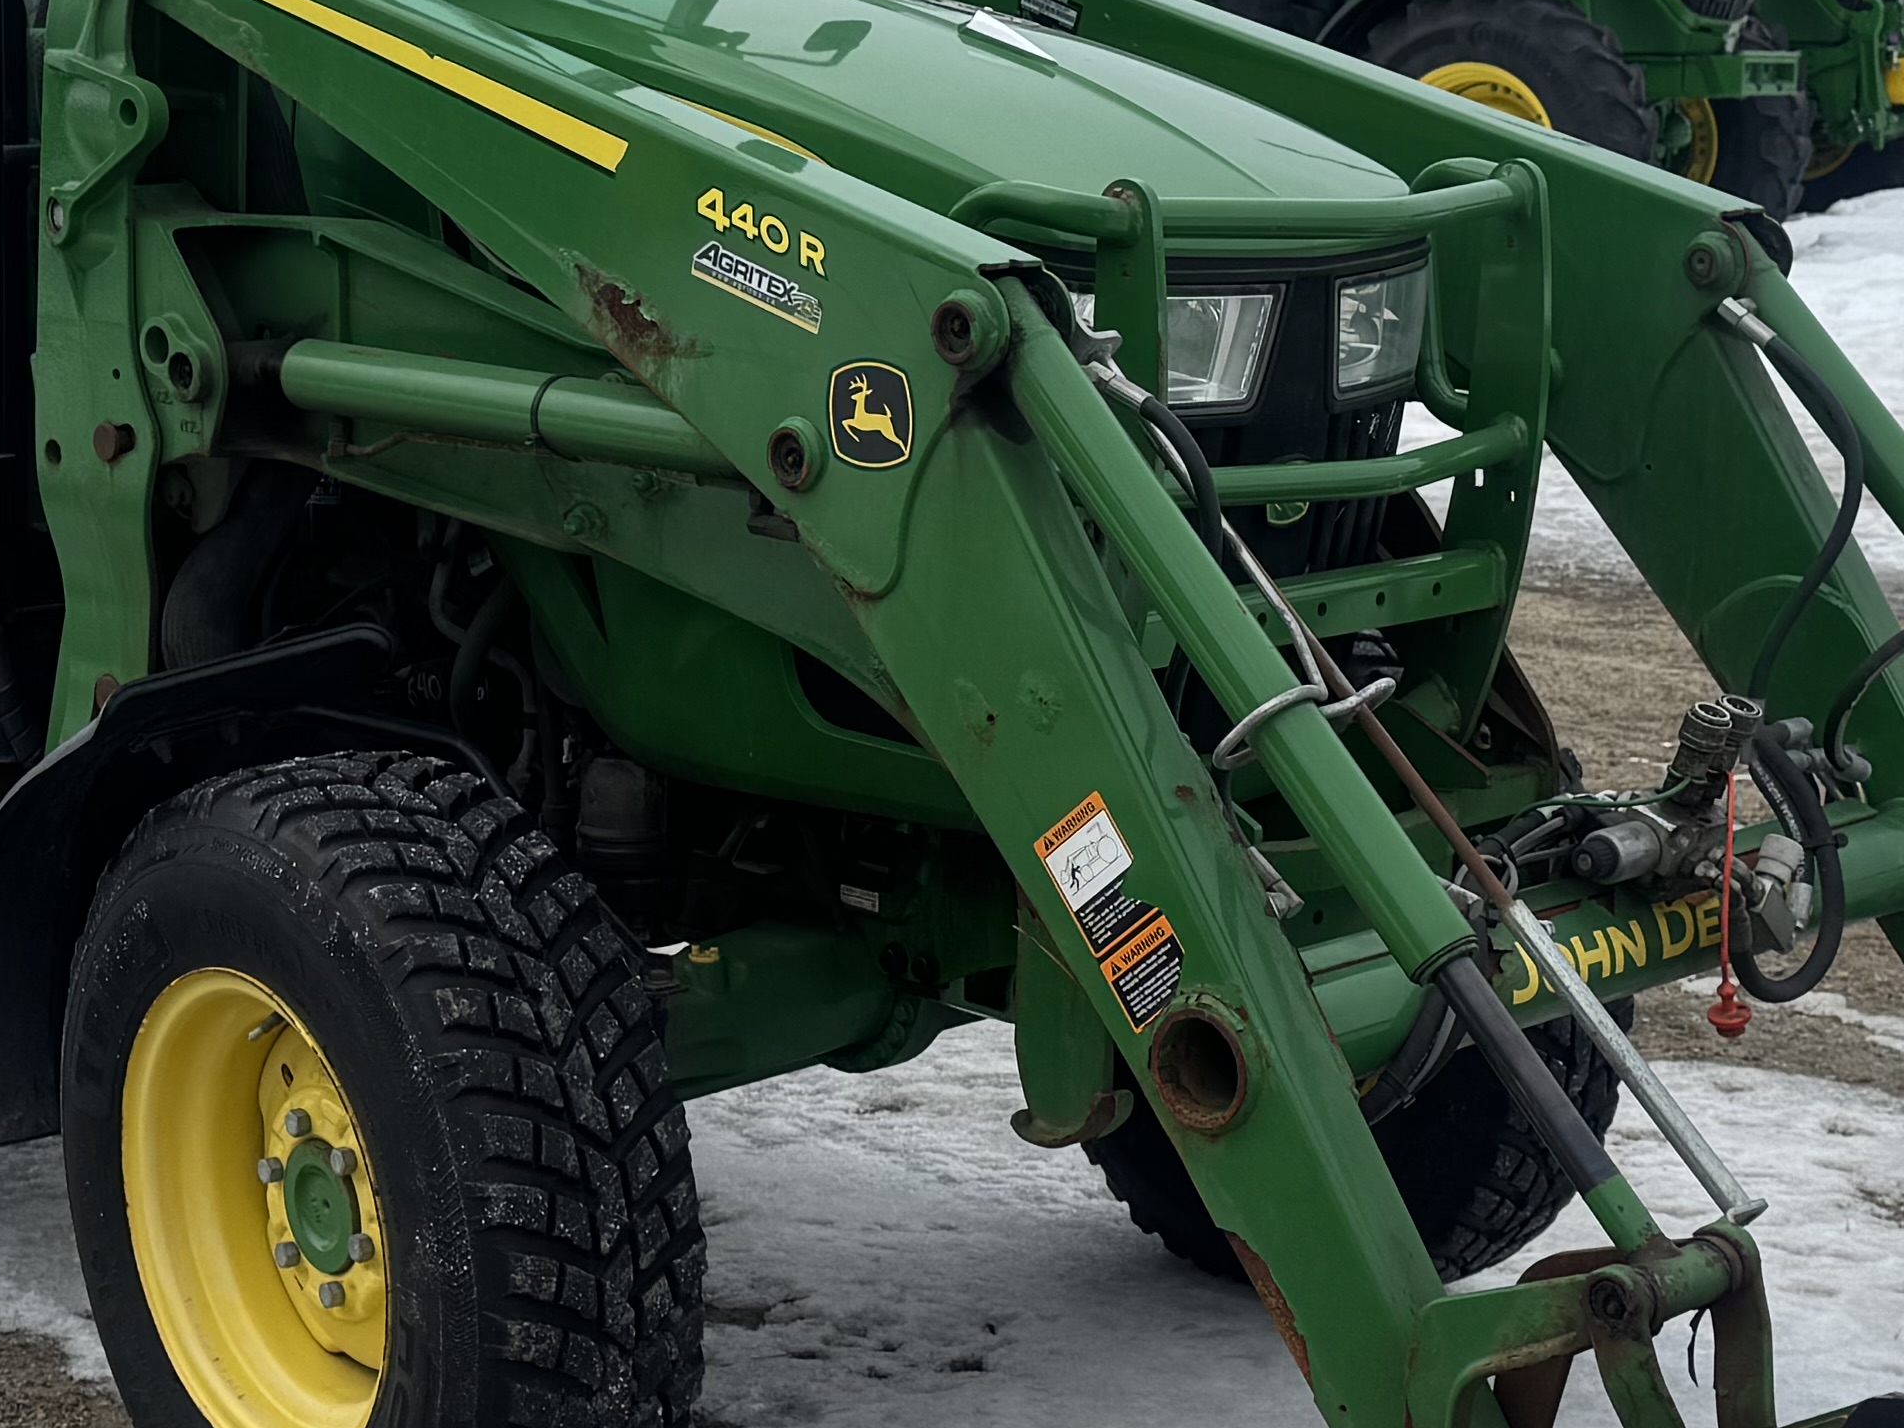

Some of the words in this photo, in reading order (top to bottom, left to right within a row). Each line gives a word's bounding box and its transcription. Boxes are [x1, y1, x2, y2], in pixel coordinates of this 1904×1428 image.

[697, 187, 790, 255] 440
[799, 230, 826, 277] R
[695, 241, 797, 305] AGRITEX
[1052, 801, 1096, 842] WARNING
[1119, 926, 1166, 966] WARNING
